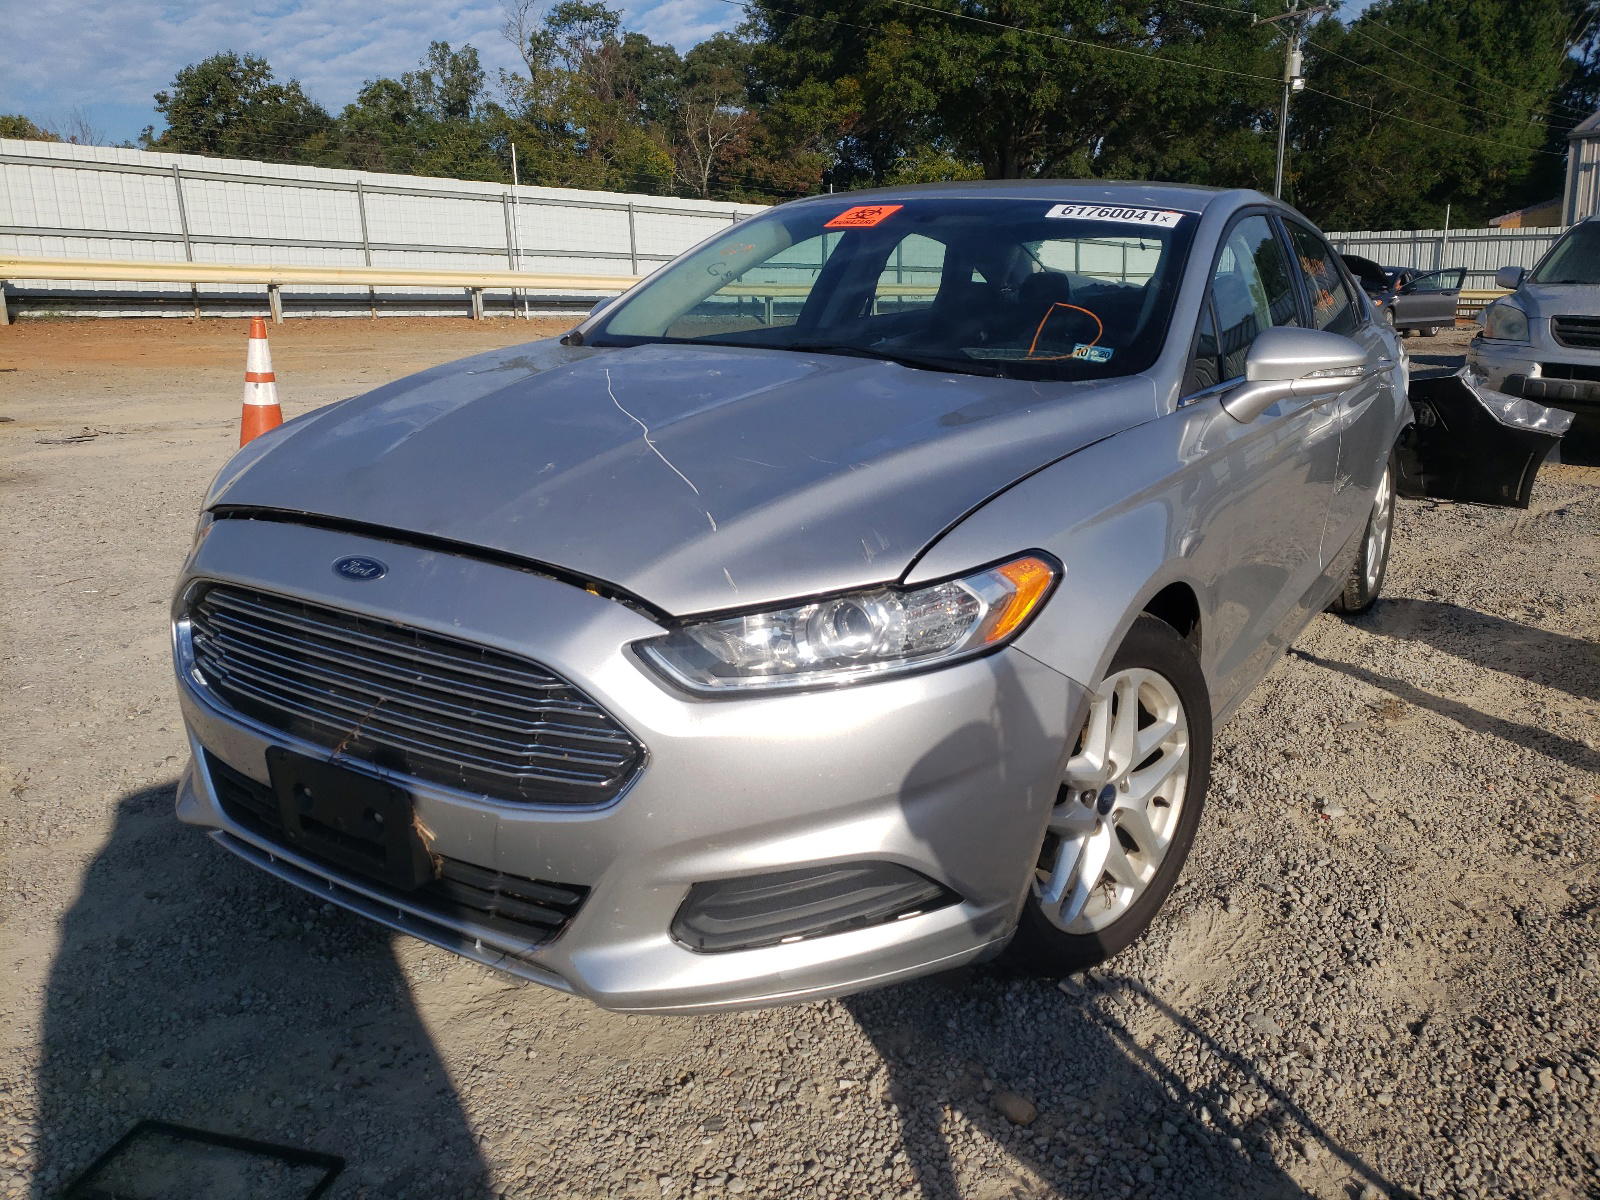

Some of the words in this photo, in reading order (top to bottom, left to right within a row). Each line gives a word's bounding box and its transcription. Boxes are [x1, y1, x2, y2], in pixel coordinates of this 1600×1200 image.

[1076, 347, 1089, 357] 10
[1099, 350, 1111, 359] 20
[341, 560, 377, 577] Ford
